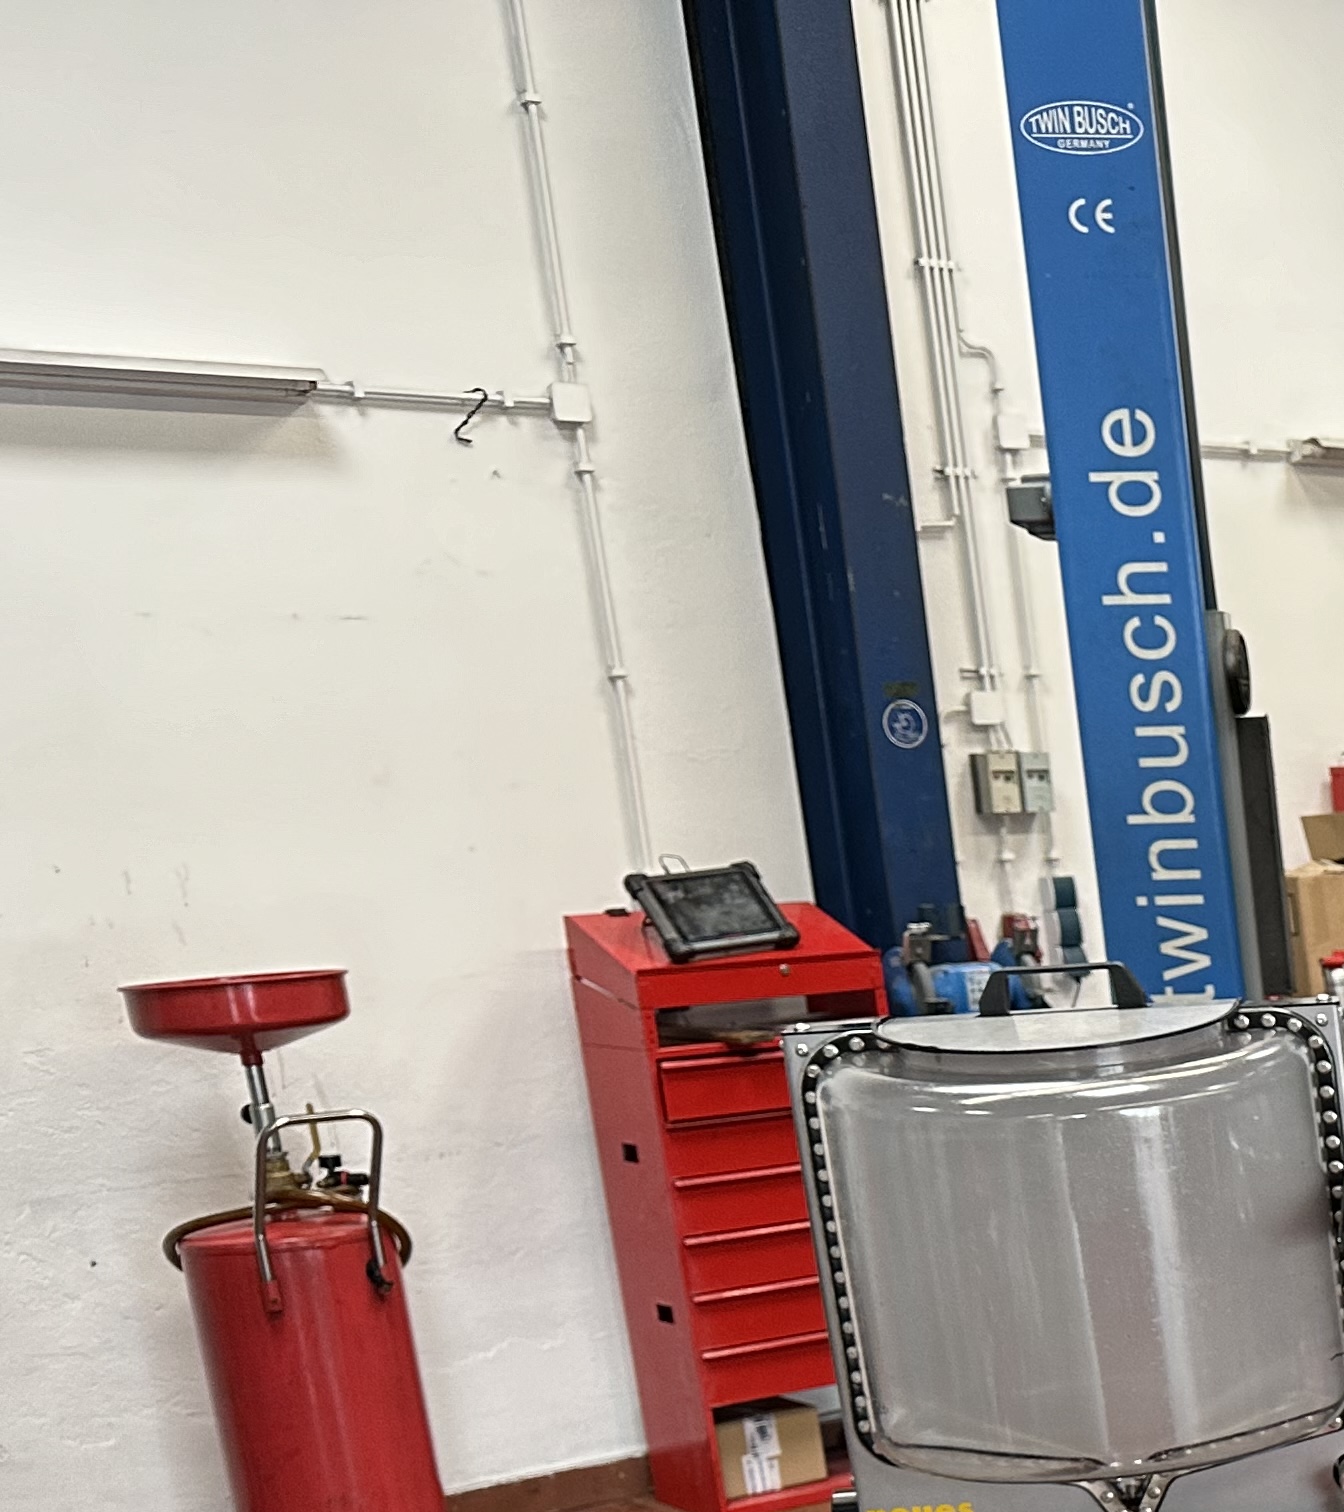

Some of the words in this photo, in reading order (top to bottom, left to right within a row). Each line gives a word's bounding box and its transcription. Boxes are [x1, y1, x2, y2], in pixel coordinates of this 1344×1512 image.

[1028, 106, 1071, 134] TWIN
[1073, 105, 1132, 135] BUSCH
[1057, 138, 1110, 149] GERMANY
[1068, 198, 1116, 234] CE
